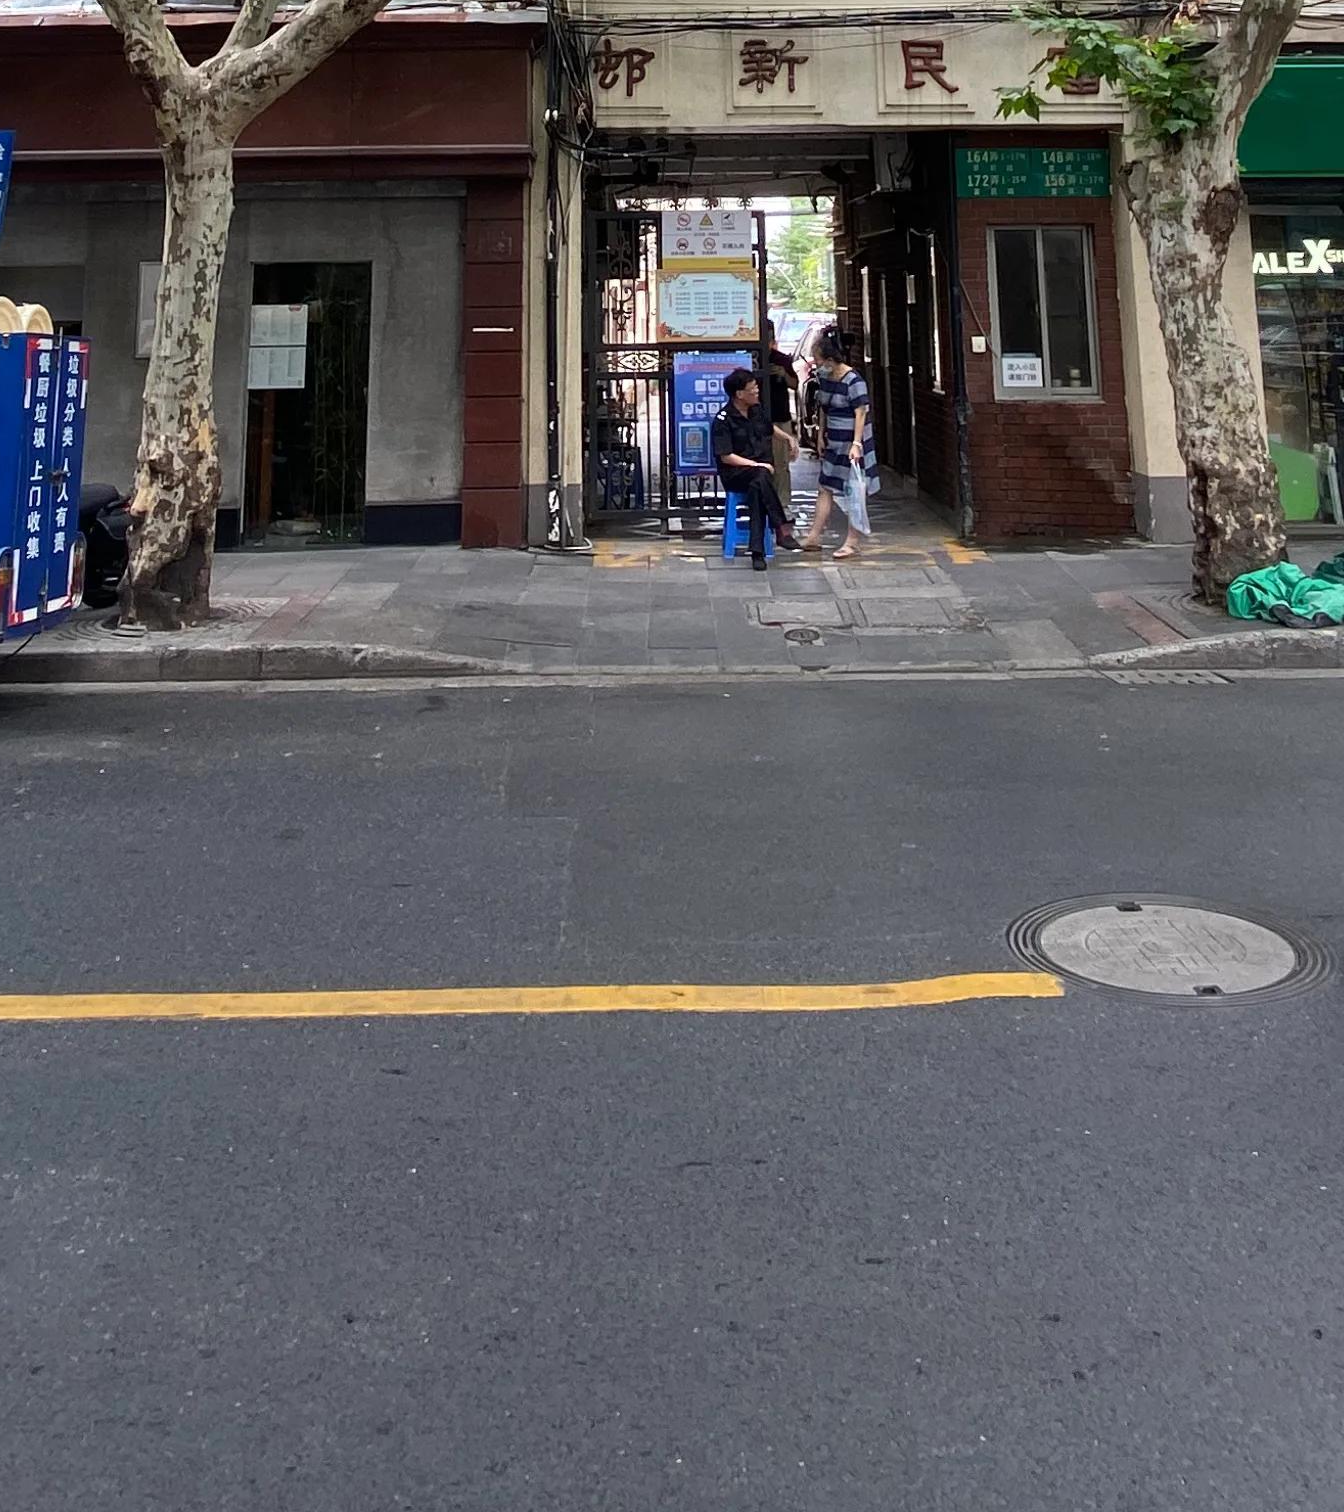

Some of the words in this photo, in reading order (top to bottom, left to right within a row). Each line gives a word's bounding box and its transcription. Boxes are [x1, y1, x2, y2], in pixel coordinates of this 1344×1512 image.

[1252, 238, 1334, 275] ALEX
[32, 352, 51, 448] 餐厨垃圾
[62, 355, 80, 447] 垃圾分类
[26, 460, 44, 559] 上门收集
[53, 458, 72, 554] 人人有责
